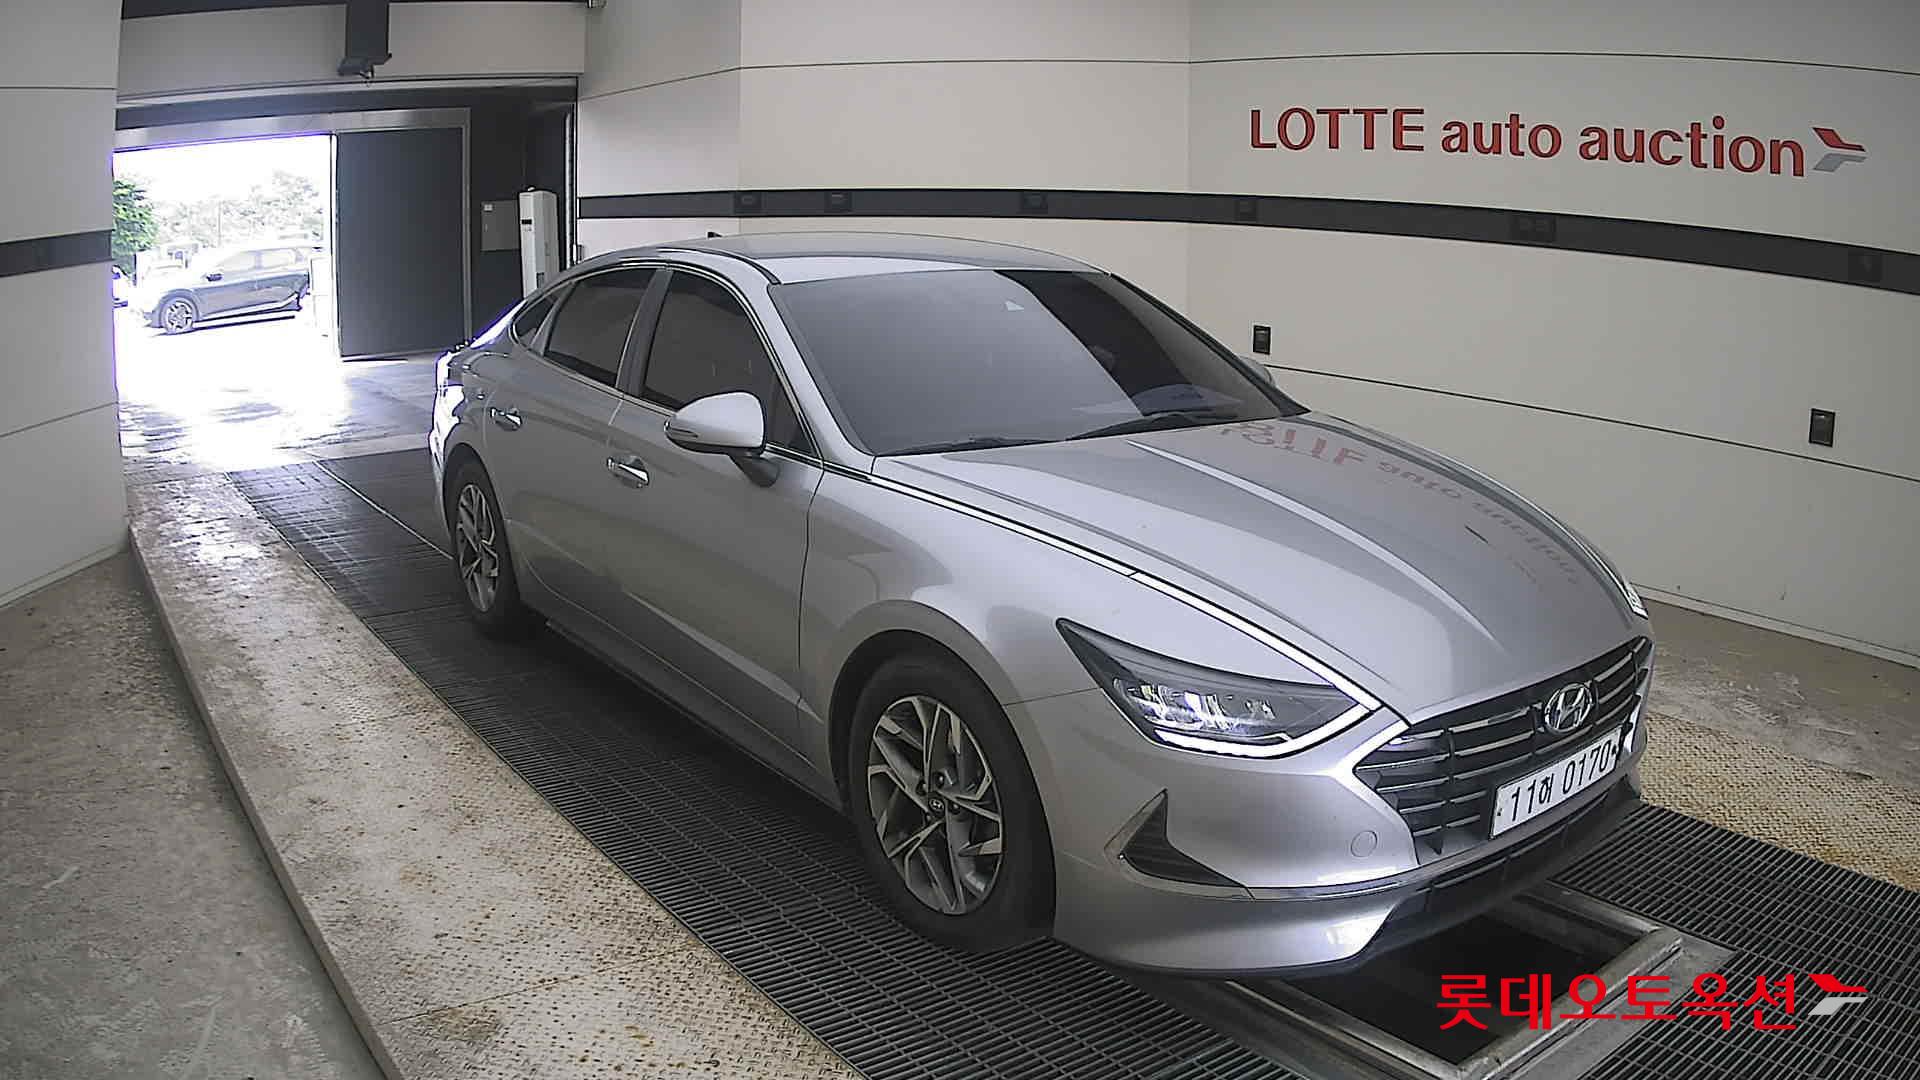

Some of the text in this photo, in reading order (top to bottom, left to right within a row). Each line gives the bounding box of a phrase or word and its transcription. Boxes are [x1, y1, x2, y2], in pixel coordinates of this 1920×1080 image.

[1250, 107, 1806, 177] LOTTE auto auction
[1562, 739, 1613, 795] 0170
